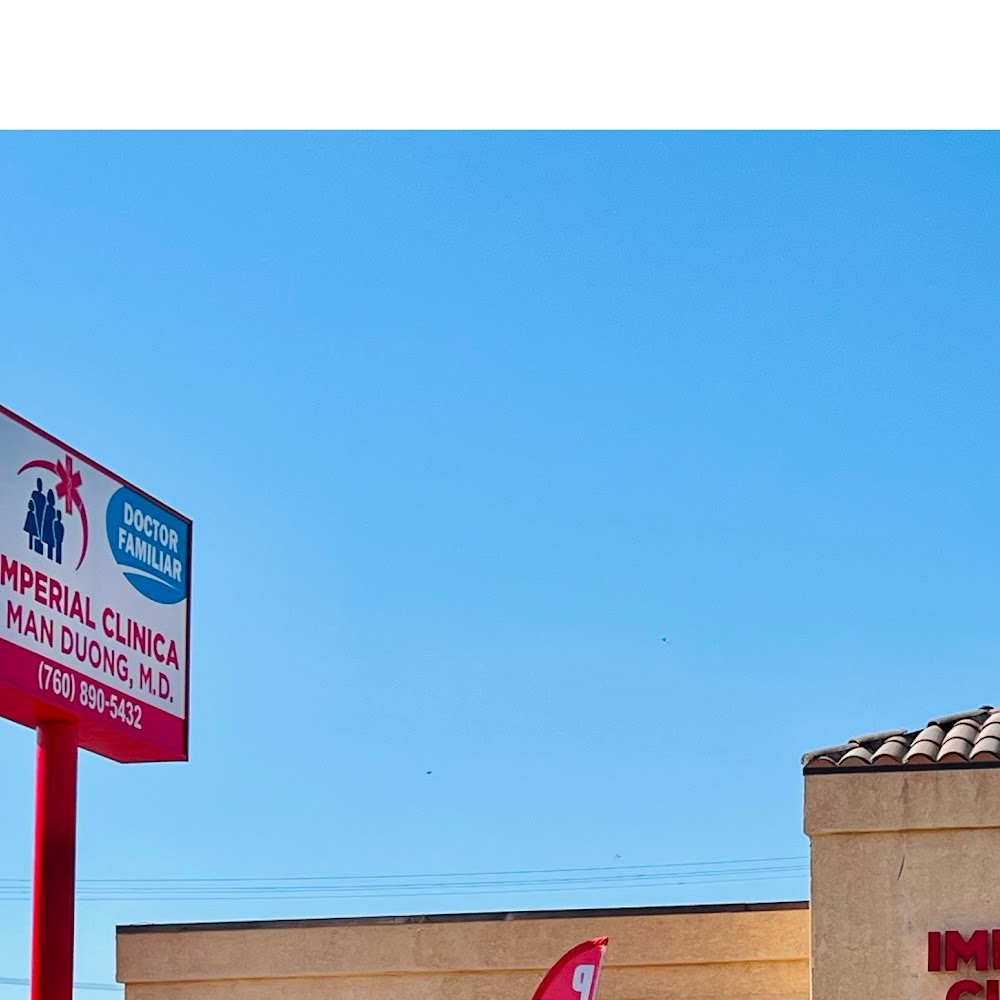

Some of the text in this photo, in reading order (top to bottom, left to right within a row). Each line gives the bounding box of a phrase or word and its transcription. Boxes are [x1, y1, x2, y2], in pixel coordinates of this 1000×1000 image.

[118, 528, 182, 582] FAMILIAR
[124, 502, 178, 553] DOCTOR
[0, 554, 179, 670] MPERIAL CLINICA
[7, 600, 173, 703] MAN DUONG, M.D.
[38, 661, 142, 729] (760) 890-5432
